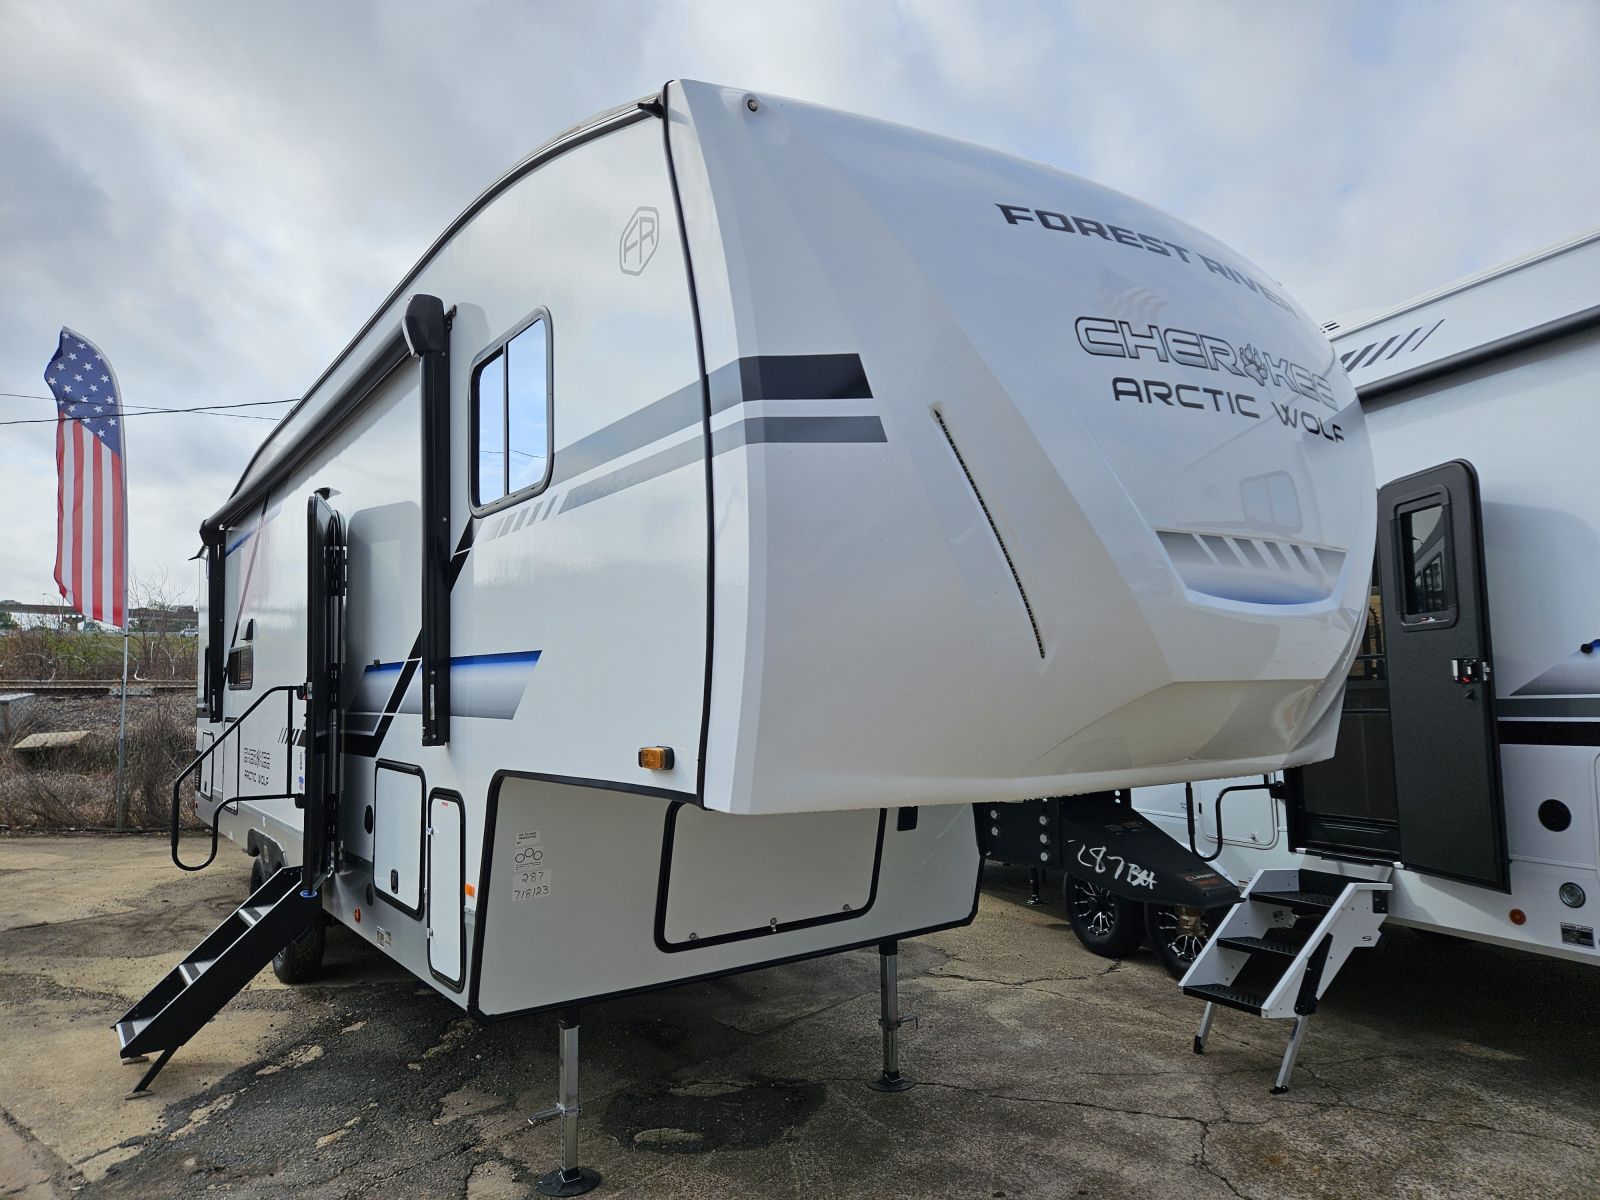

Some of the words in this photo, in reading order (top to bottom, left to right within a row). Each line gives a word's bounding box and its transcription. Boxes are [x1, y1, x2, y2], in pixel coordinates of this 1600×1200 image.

[993, 202, 1190, 264] FOREST
[1196, 252, 1302, 321] RIVER
[1111, 376, 1261, 419] ARCTIC
[1270, 400, 1345, 443] WOLF
[521, 871, 545, 884] 287
